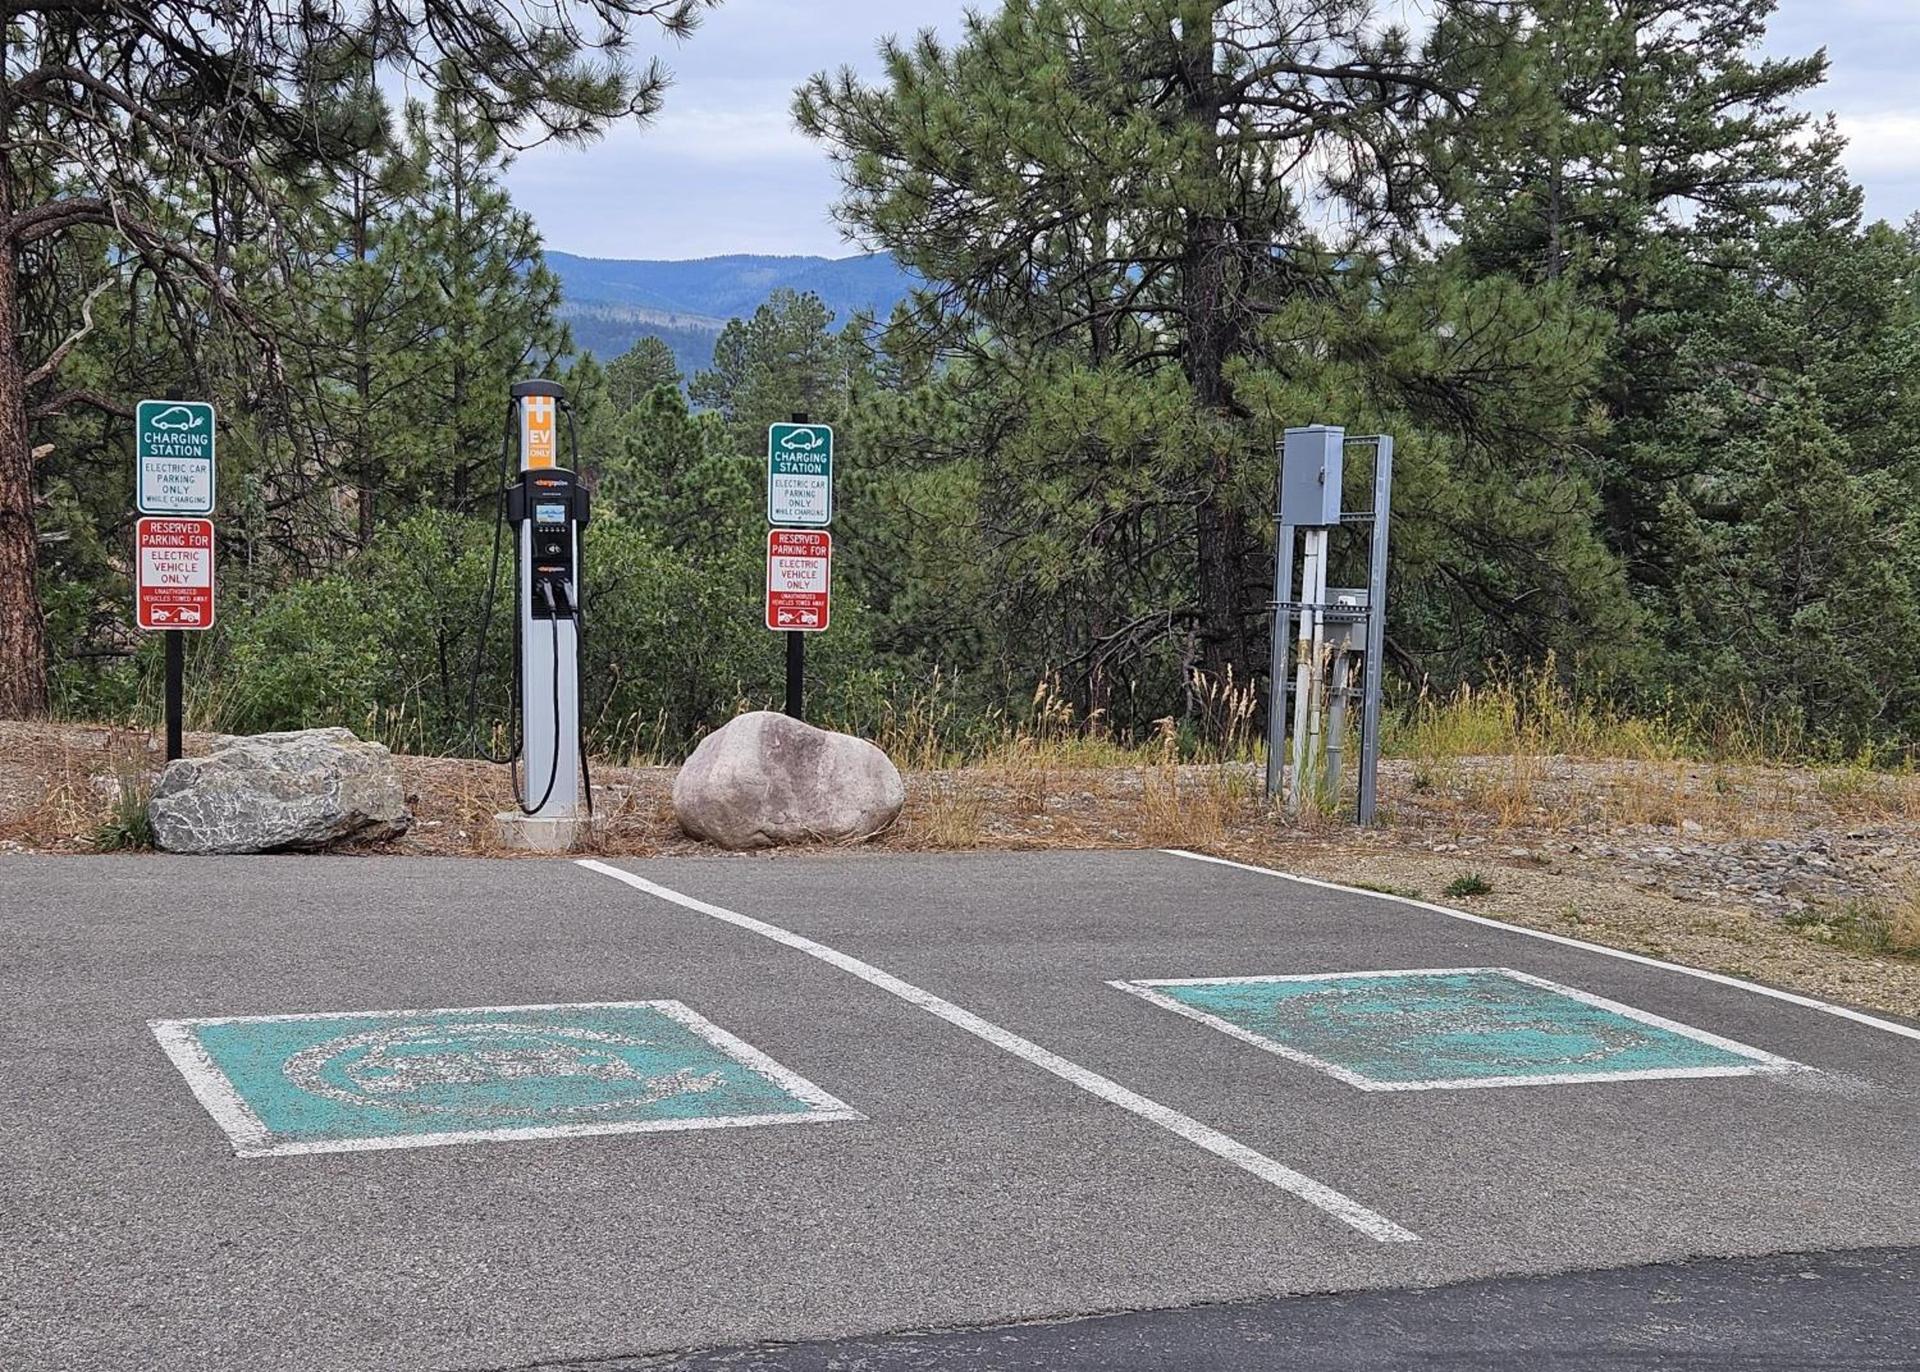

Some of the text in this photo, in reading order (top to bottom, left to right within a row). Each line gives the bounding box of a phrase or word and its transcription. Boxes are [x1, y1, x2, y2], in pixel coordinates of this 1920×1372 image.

[144, 432, 208, 445] CHARGING
[529, 429, 550, 444] EV
[150, 445, 202, 456] STATION
[529, 448, 550, 457] ONLY
[774, 451, 828, 463] CHARGING
[145, 463, 207, 473] ELECTRIC CAR
[779, 462, 822, 474] STATION
[156, 474, 195, 484] PARKING
[161, 485, 190, 494] ONLY
[775, 480, 826, 489] ELECTRIC CAR
[784, 490, 816, 498] PARKING
[146, 495, 206, 504] WHILE CHARGING
[788, 499, 812, 508] ONLY
[150, 522, 200, 534] RESERVED
[142, 534, 209, 546] PARKING FOR
[779, 533, 820, 545] RESERVED
[771, 544, 827, 556] PARKING FOR
[151, 551, 200, 560] ELECTRIC
[153, 562, 198, 572] VEHICLE
[779, 560, 819, 569] ELECTRIC
[160, 574, 190, 584] ONLY
[781, 570, 817, 579] VEHICLE
[786, 580, 810, 590] ONLY
